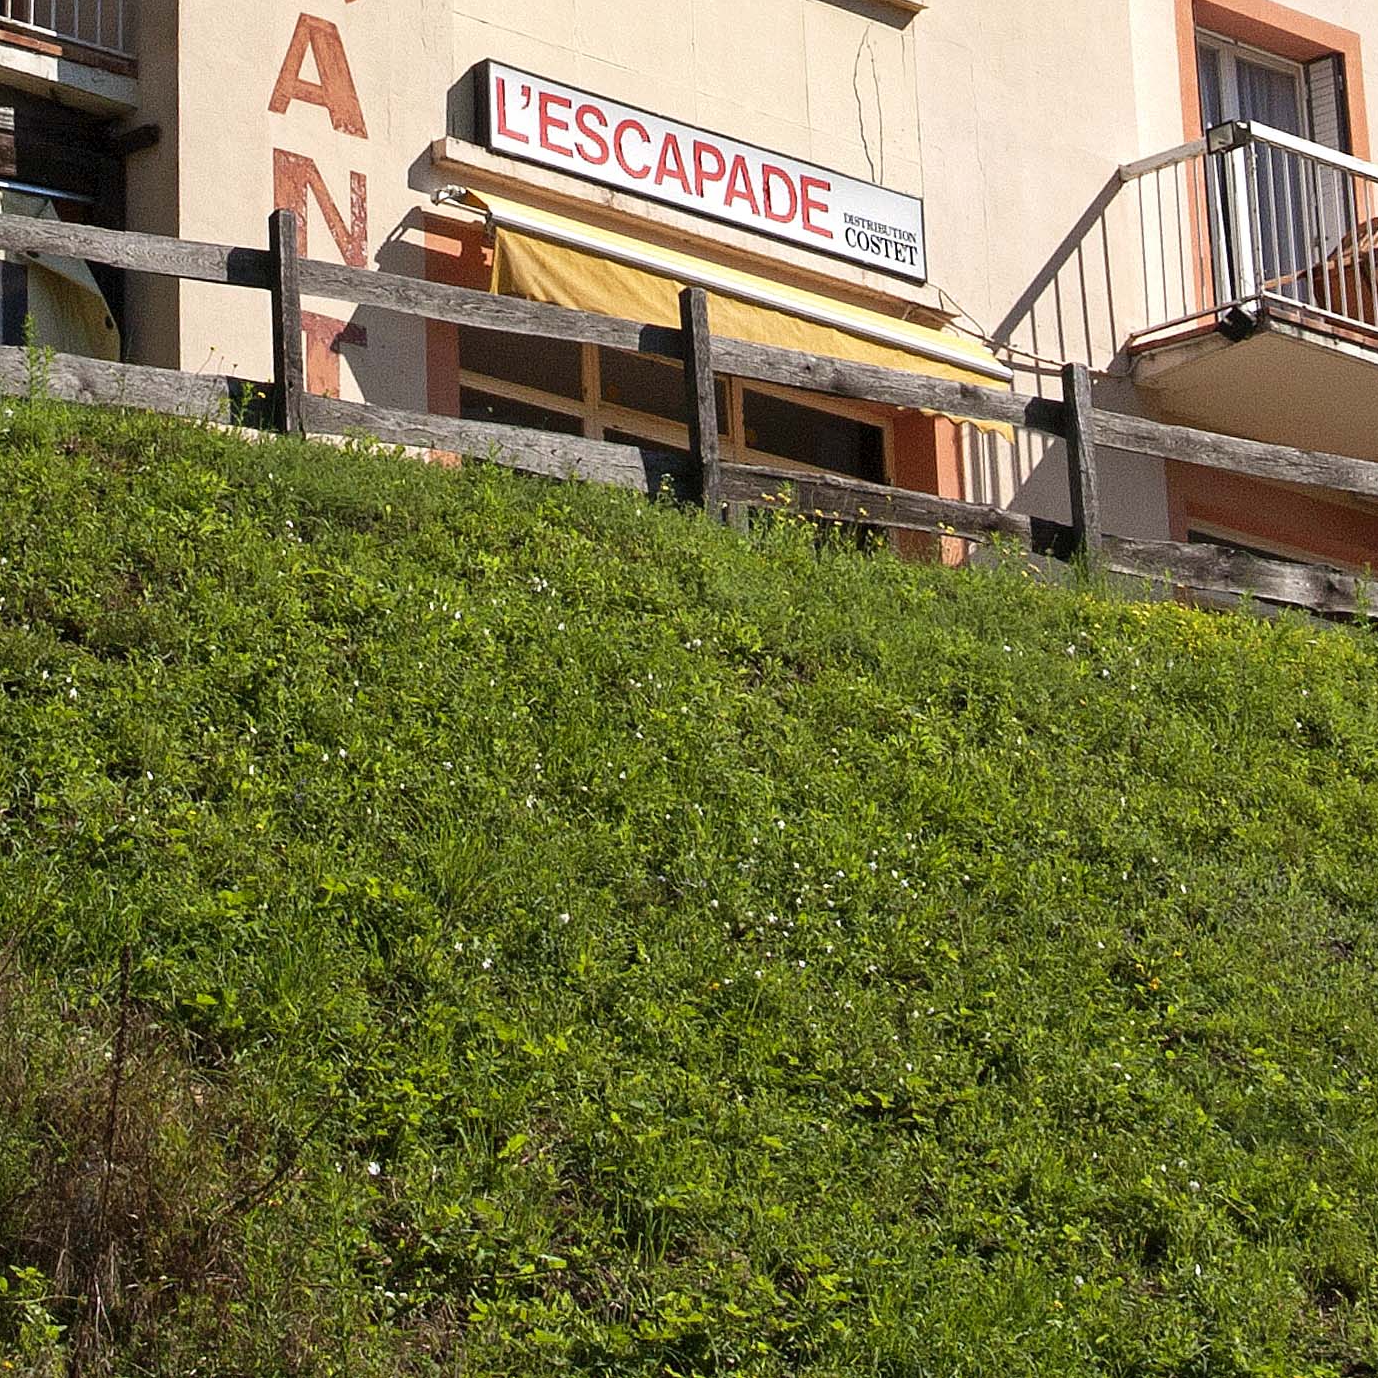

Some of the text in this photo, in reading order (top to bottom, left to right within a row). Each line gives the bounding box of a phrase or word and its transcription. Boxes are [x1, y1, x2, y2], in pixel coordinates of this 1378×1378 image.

[496, 76, 834, 239] L'ESCAPADE
[843, 212, 917, 244] DISTRIBUTION
[845, 227, 918, 266] COSTET
